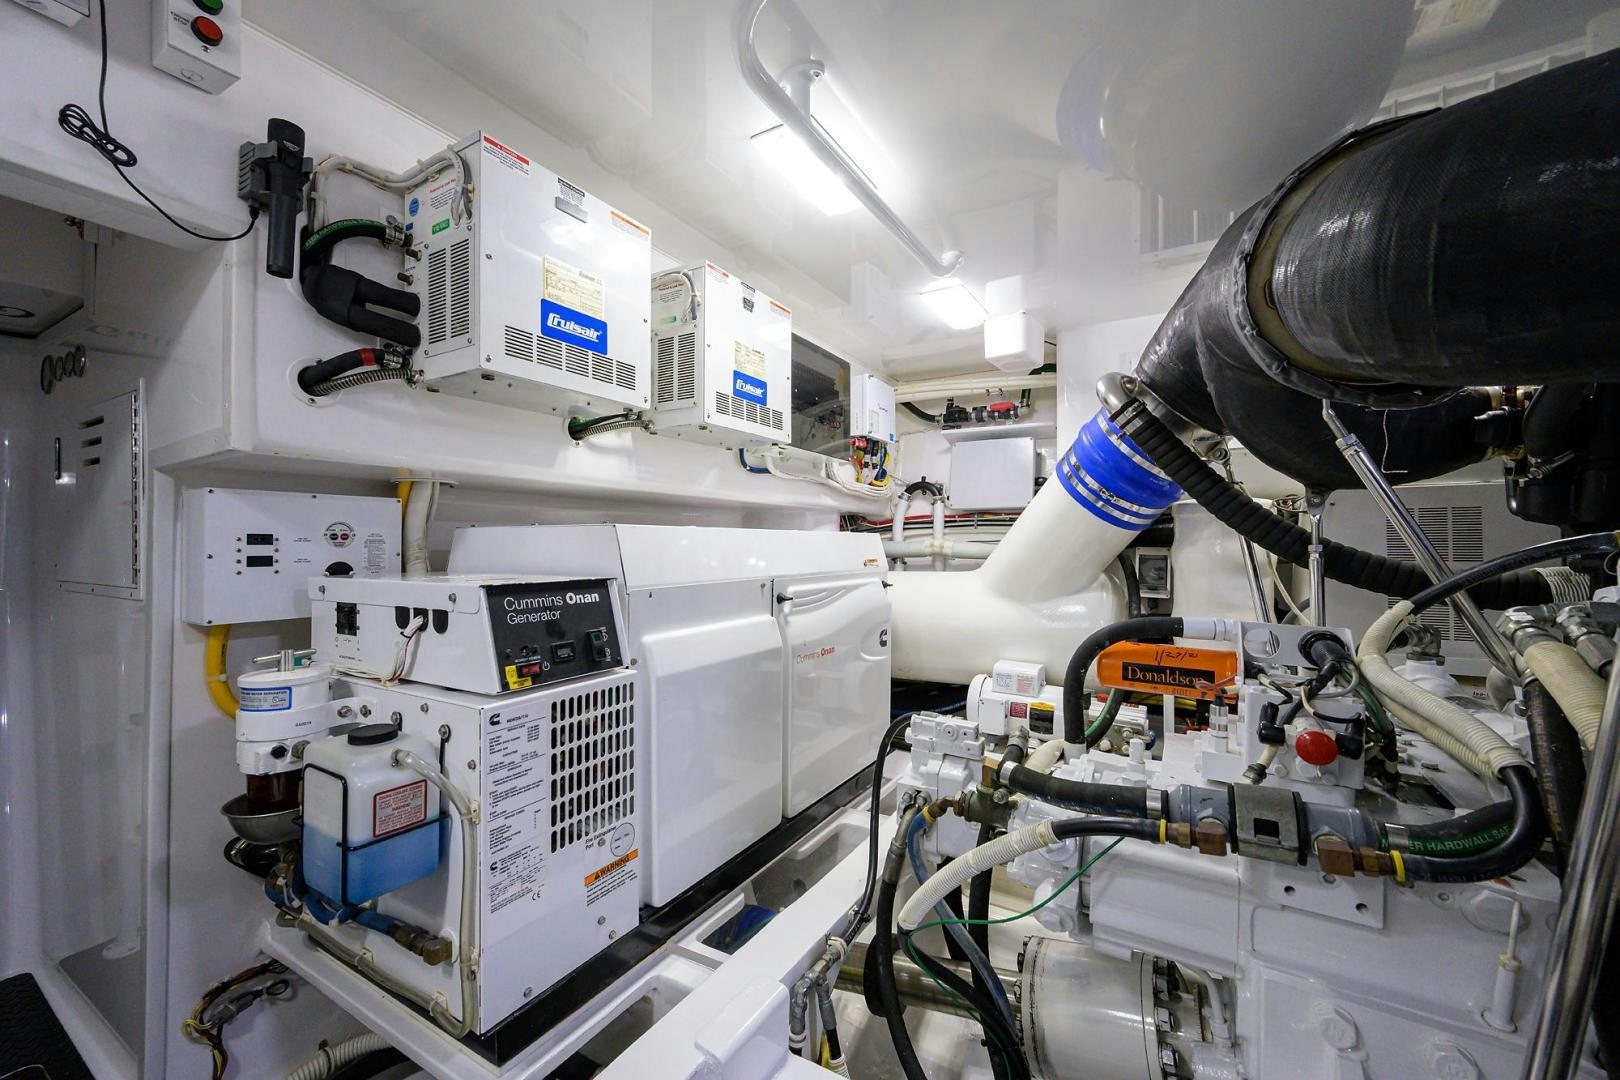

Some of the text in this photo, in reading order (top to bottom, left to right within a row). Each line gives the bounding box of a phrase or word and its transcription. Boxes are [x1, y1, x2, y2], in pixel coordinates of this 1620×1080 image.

[547, 312, 602, 342] Cruisair
[736, 379, 764, 398] Cruisair
[504, 592, 600, 611] Cummins Onan
[507, 610, 560, 625] Generator
[1426, 833, 1491, 851] HARDWALL
[599, 855, 631, 877] WARNING
